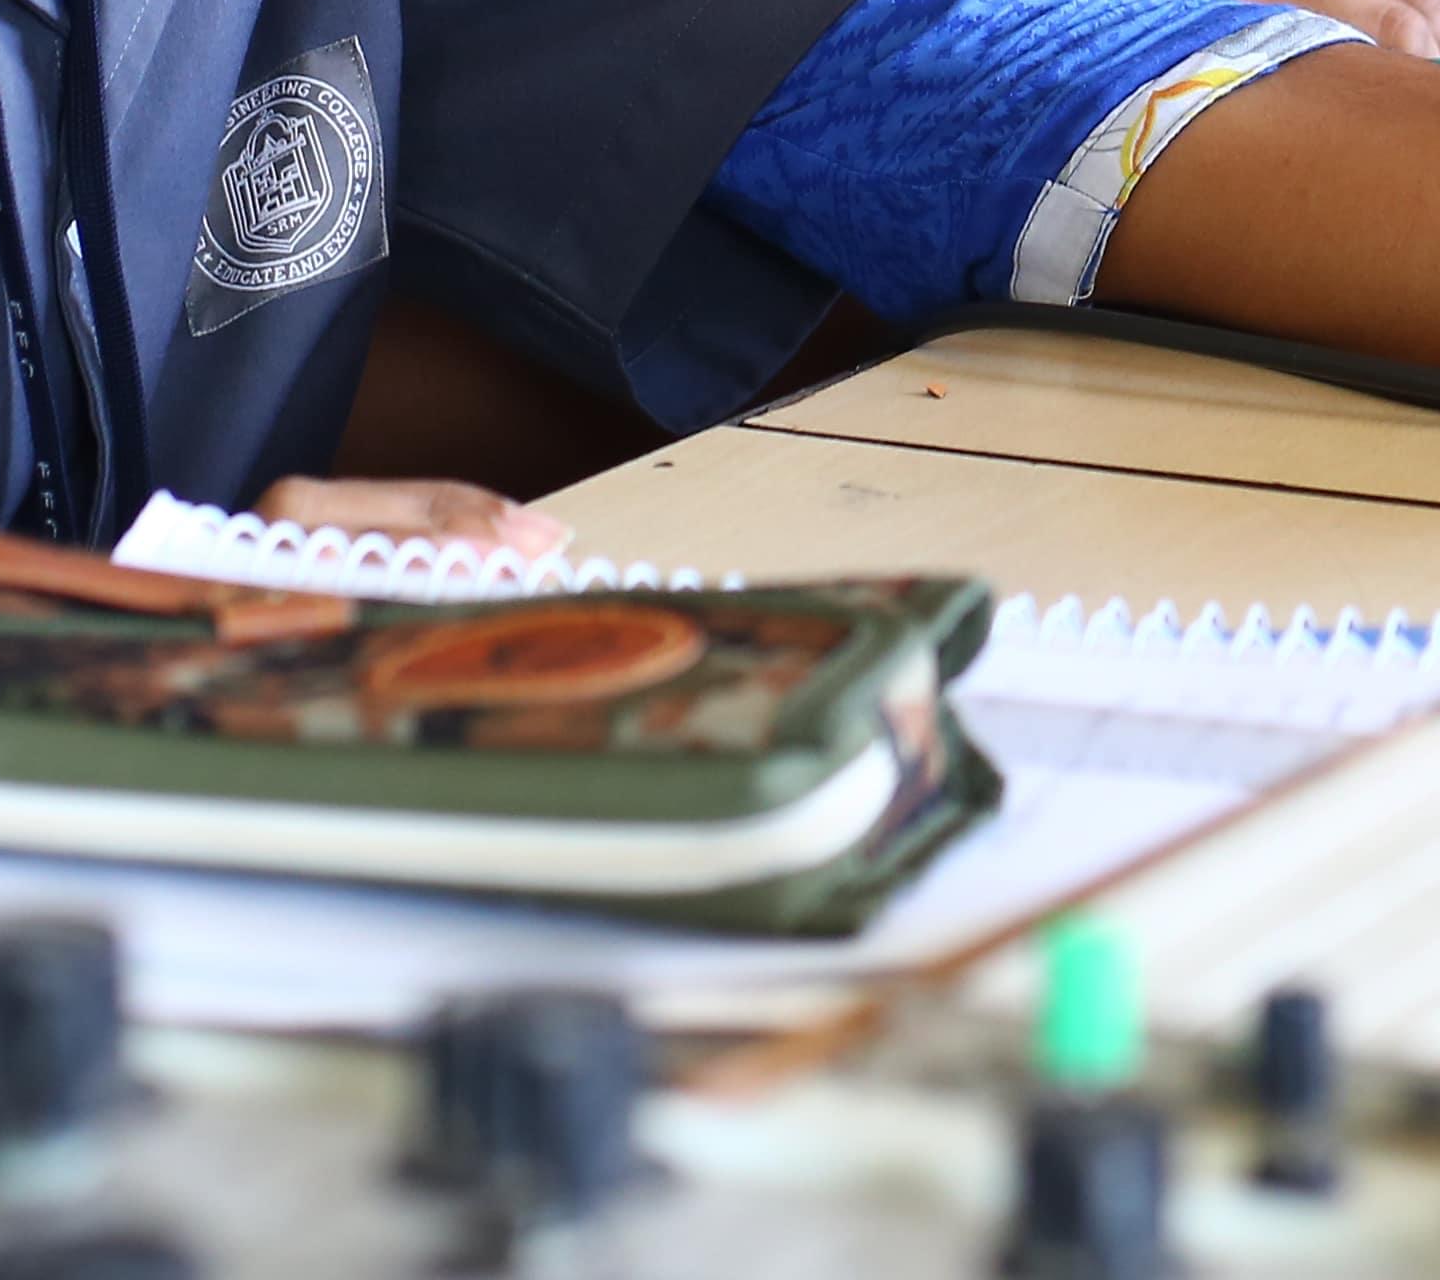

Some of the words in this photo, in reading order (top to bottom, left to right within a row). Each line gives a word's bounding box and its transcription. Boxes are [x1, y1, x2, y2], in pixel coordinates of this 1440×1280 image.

[317, 91, 367, 178] COLLEGE
[213, 257, 287, 285] EDUCATE
[288, 253, 325, 279] AND
[323, 199, 361, 259] EXCEL
[266, 211, 304, 237] SRM
